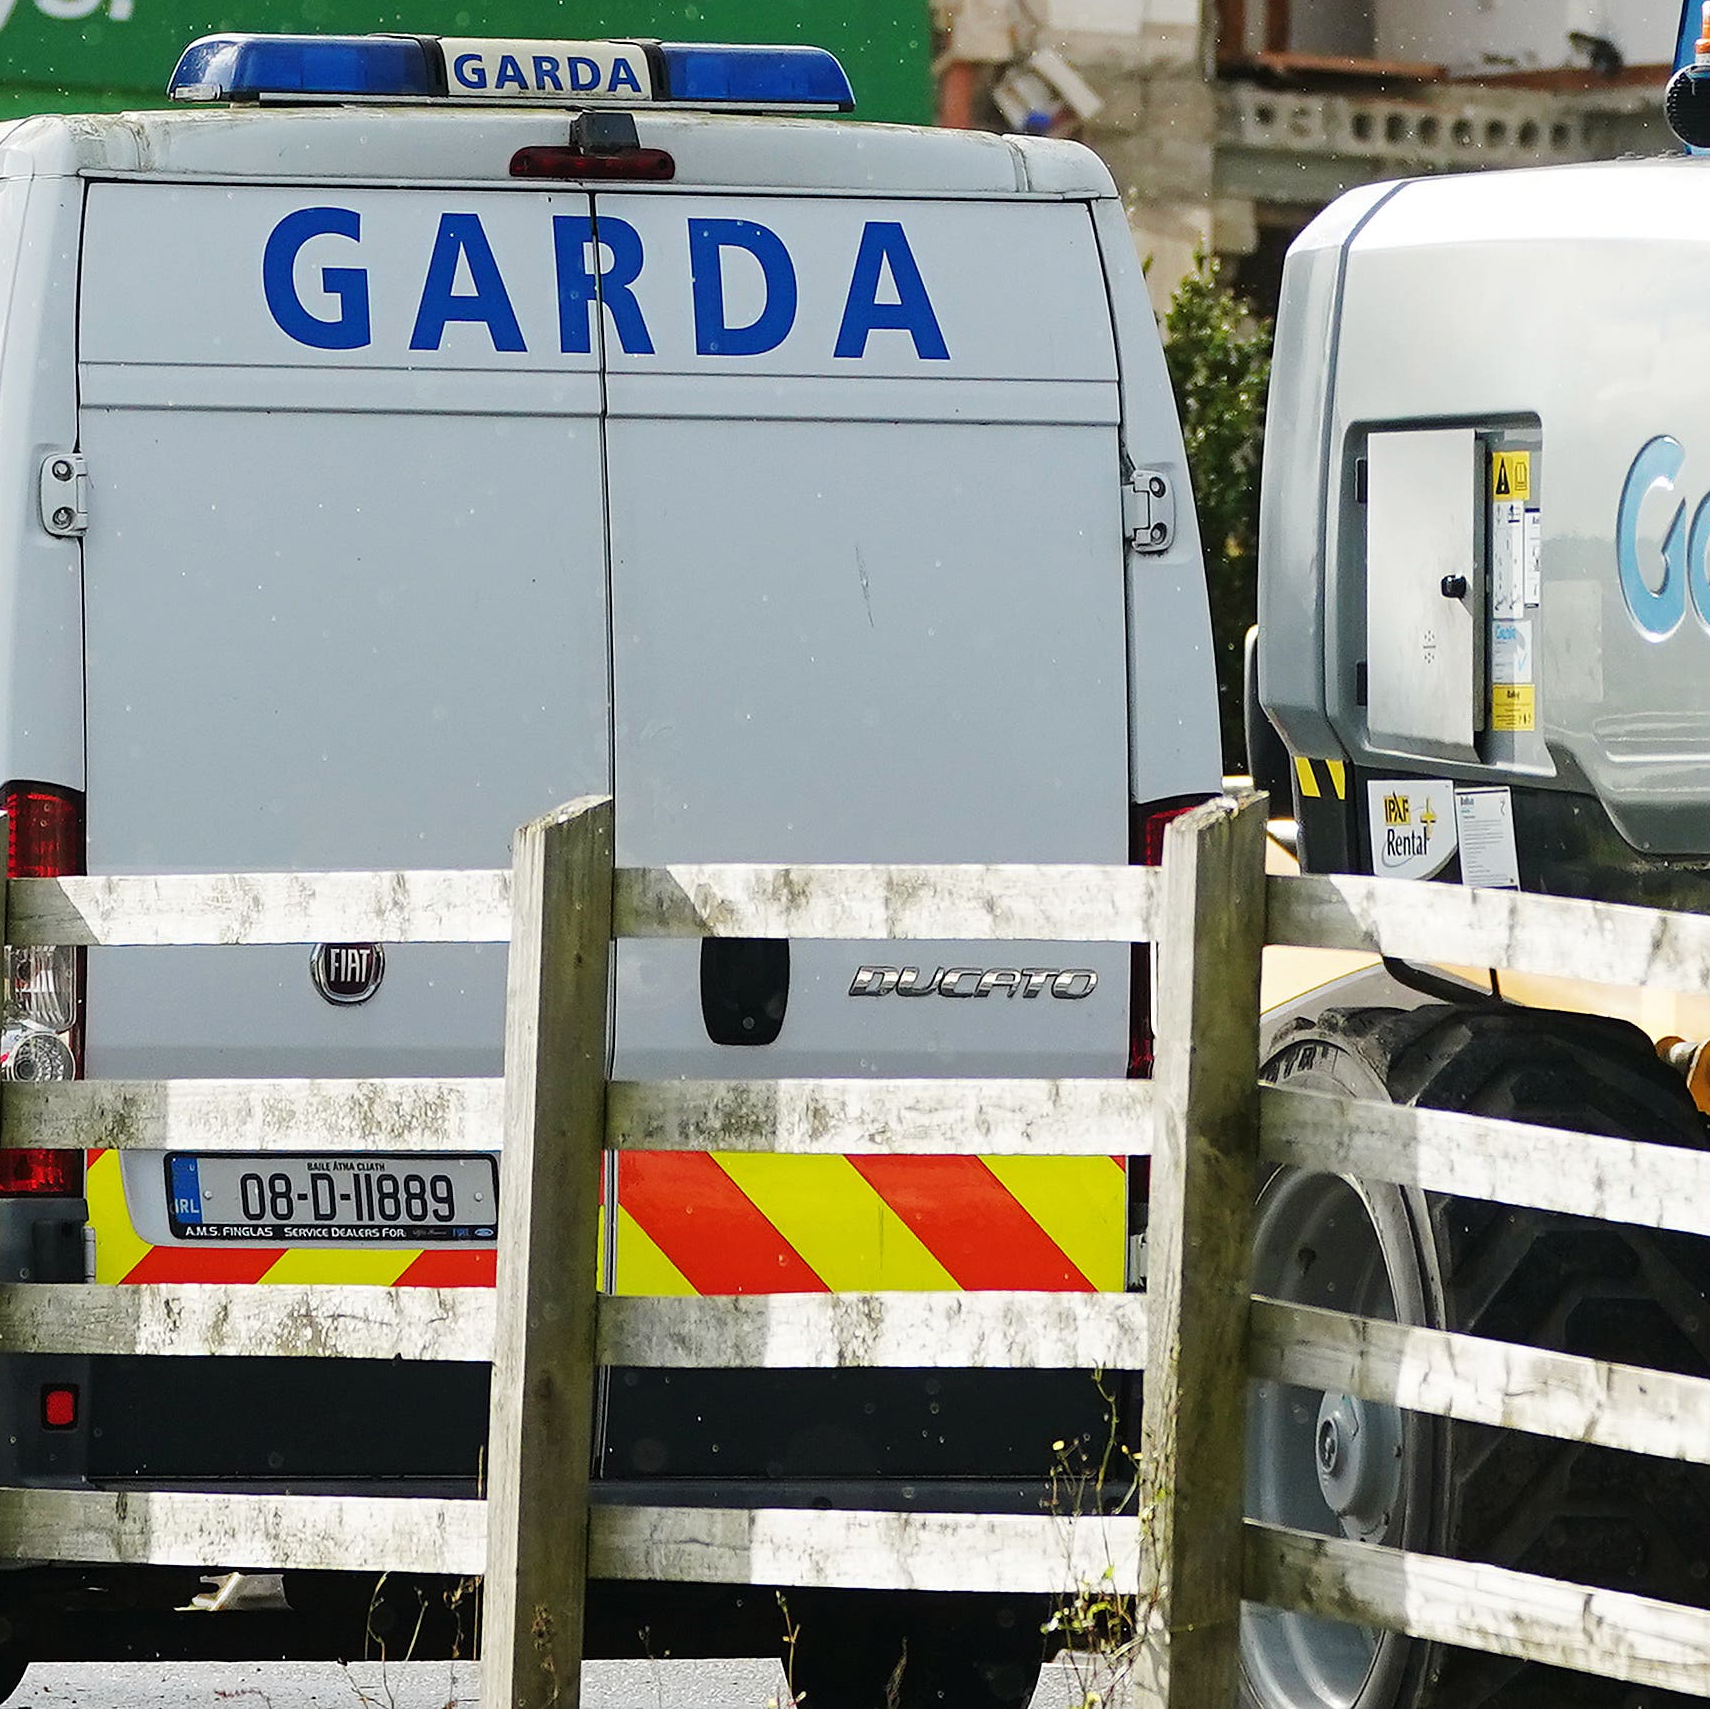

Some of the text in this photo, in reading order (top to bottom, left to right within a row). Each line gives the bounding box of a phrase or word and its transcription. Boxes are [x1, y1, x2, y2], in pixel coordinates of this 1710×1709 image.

[453, 52, 642, 93] GARDA
[261, 205, 952, 361] GARDA
[1387, 826, 1431, 856] Rental
[330, 948, 371, 983] FIAT
[848, 965, 1100, 1001] DUCATO
[175, 1198, 200, 1214] IRL
[240, 1172, 456, 1223] 08-D-11889
[185, 1226, 219, 1237] A.M.S.
[223, 1226, 273, 1238] FINGLAS
[284, 1227, 328, 1238] SERVICE
[331, 1227, 380, 1238] DEALERS
